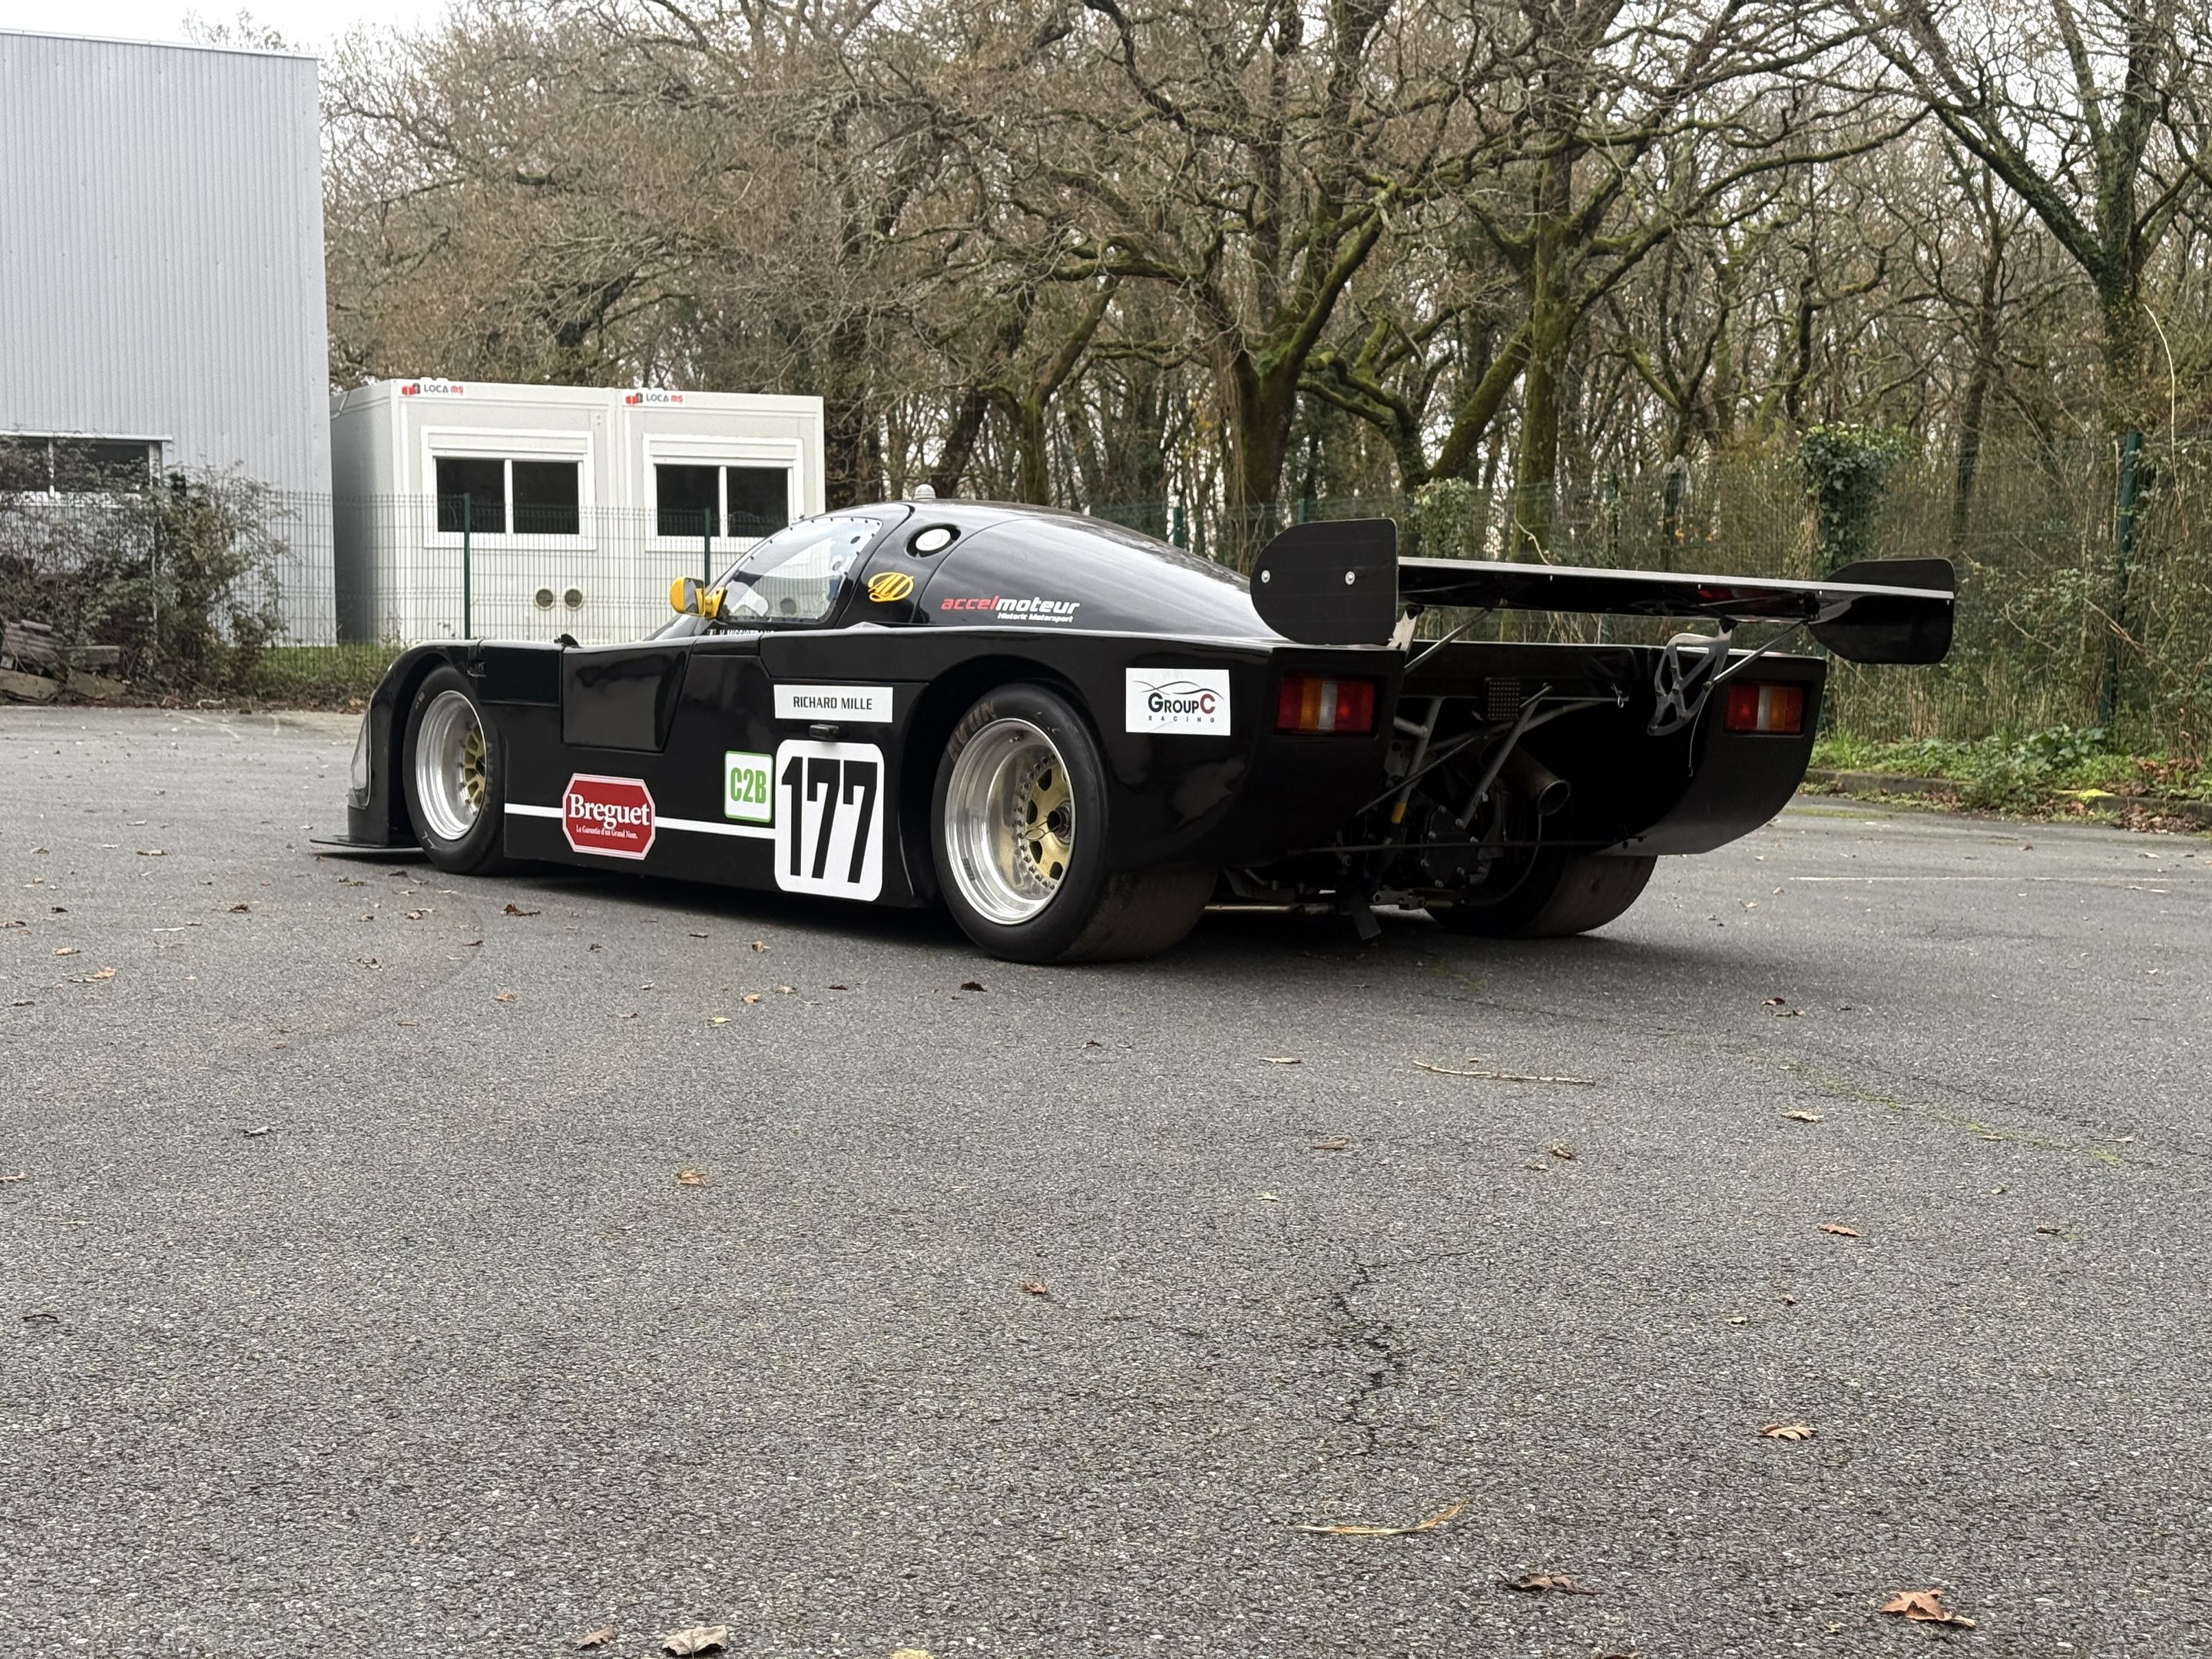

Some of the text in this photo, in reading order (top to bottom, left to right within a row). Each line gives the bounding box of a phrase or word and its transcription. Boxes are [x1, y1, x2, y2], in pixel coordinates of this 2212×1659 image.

[423, 384, 449, 394] LOCA
[646, 393, 669, 402] LOCA
[941, 594, 1081, 614] accelmoteur
[997, 612, 1074, 624] Historic Motorsport
[793, 696, 873, 710] RICHARD MILLE
[730, 767, 767, 804] C2B
[568, 793, 651, 830] Breguet
[781, 756, 878, 883] 177
[576, 824, 582, 833] La
[582, 825, 601, 836] Garantie
[611, 829, 625, 839] Grand
